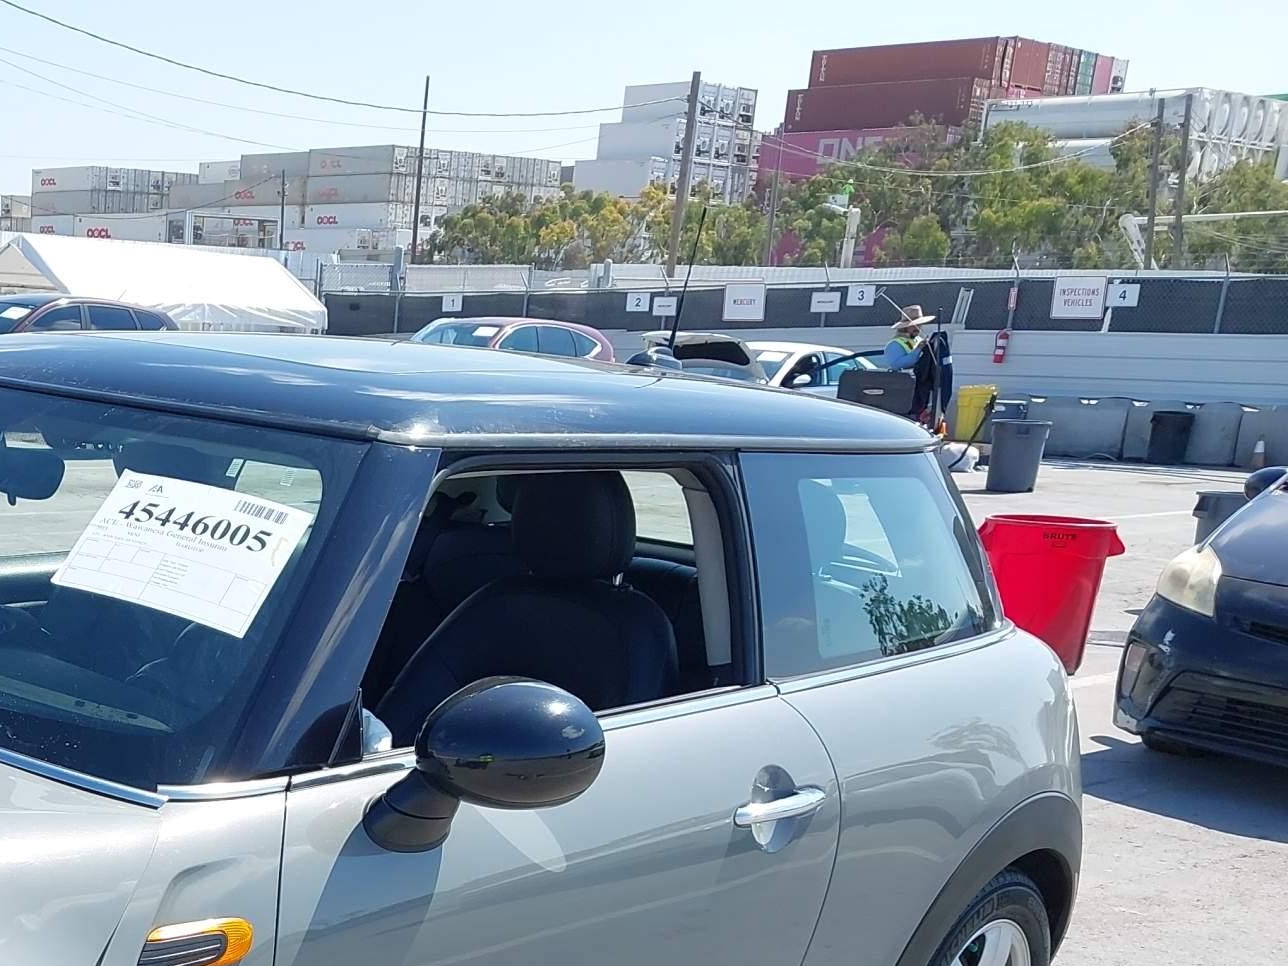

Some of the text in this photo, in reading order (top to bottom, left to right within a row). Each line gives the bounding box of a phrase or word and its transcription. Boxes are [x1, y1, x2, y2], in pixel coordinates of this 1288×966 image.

[316, 215, 339, 225] OOCL
[86, 227, 111, 239] OOCL
[856, 289, 866, 301] 3
[1059, 287, 1100, 297] INSPECTIONS
[1118, 289, 1128, 301] 4
[634, 297, 643, 308] 2
[1063, 298, 1093, 307] VEHICLES
[118, 499, 274, 552] 45446005
[1042, 531, 1078, 541] BRUTE
